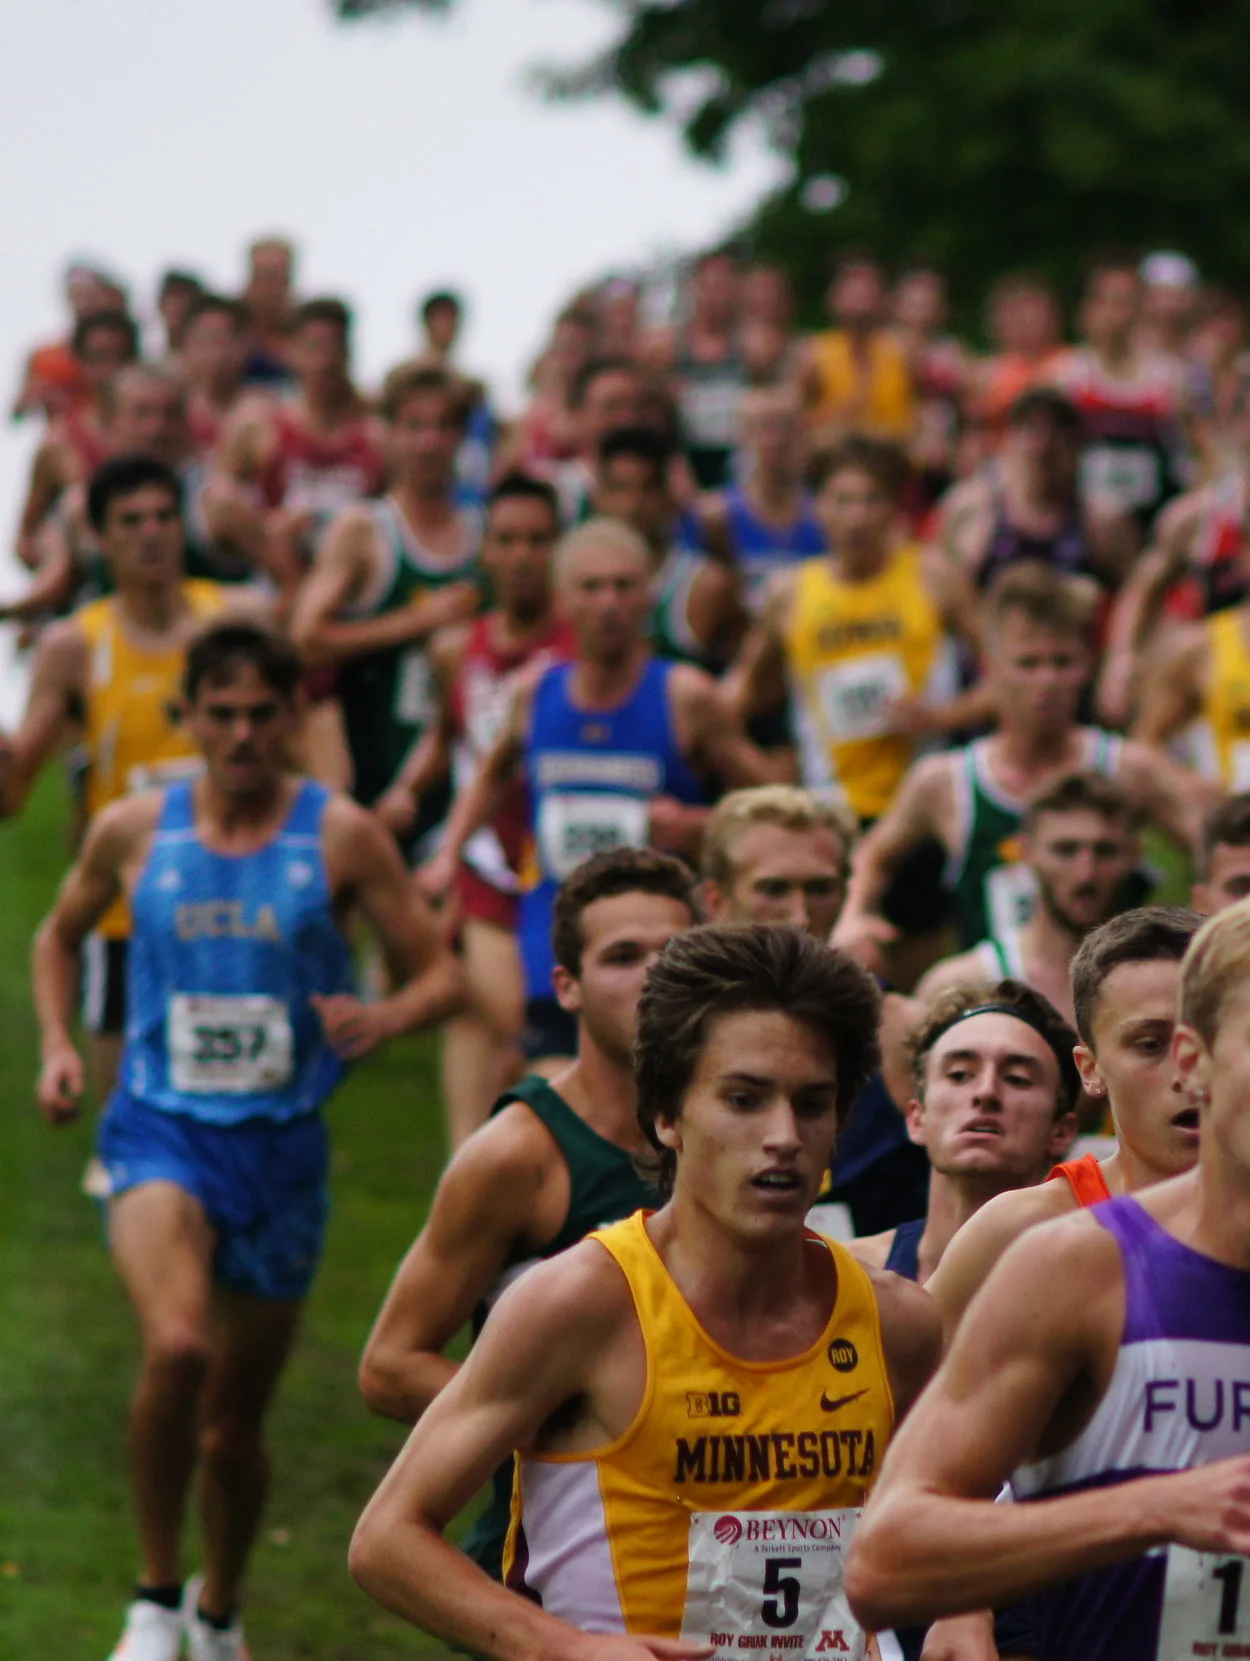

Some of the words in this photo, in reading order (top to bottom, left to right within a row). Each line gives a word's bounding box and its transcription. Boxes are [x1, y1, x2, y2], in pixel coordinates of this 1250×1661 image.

[831, 1347, 854, 1364] ROY
[673, 1428, 875, 1484] MINNESOTA
[746, 1517, 841, 1540] BEYNON
[761, 1544, 786, 1553] Tarkett
[788, 1544, 810, 1554] Sports
[812, 1543, 841, 1553] Company
[760, 1558, 802, 1628] 5
[710, 1632, 734, 1647] ROY
[771, 1634, 805, 1649] INVITE
